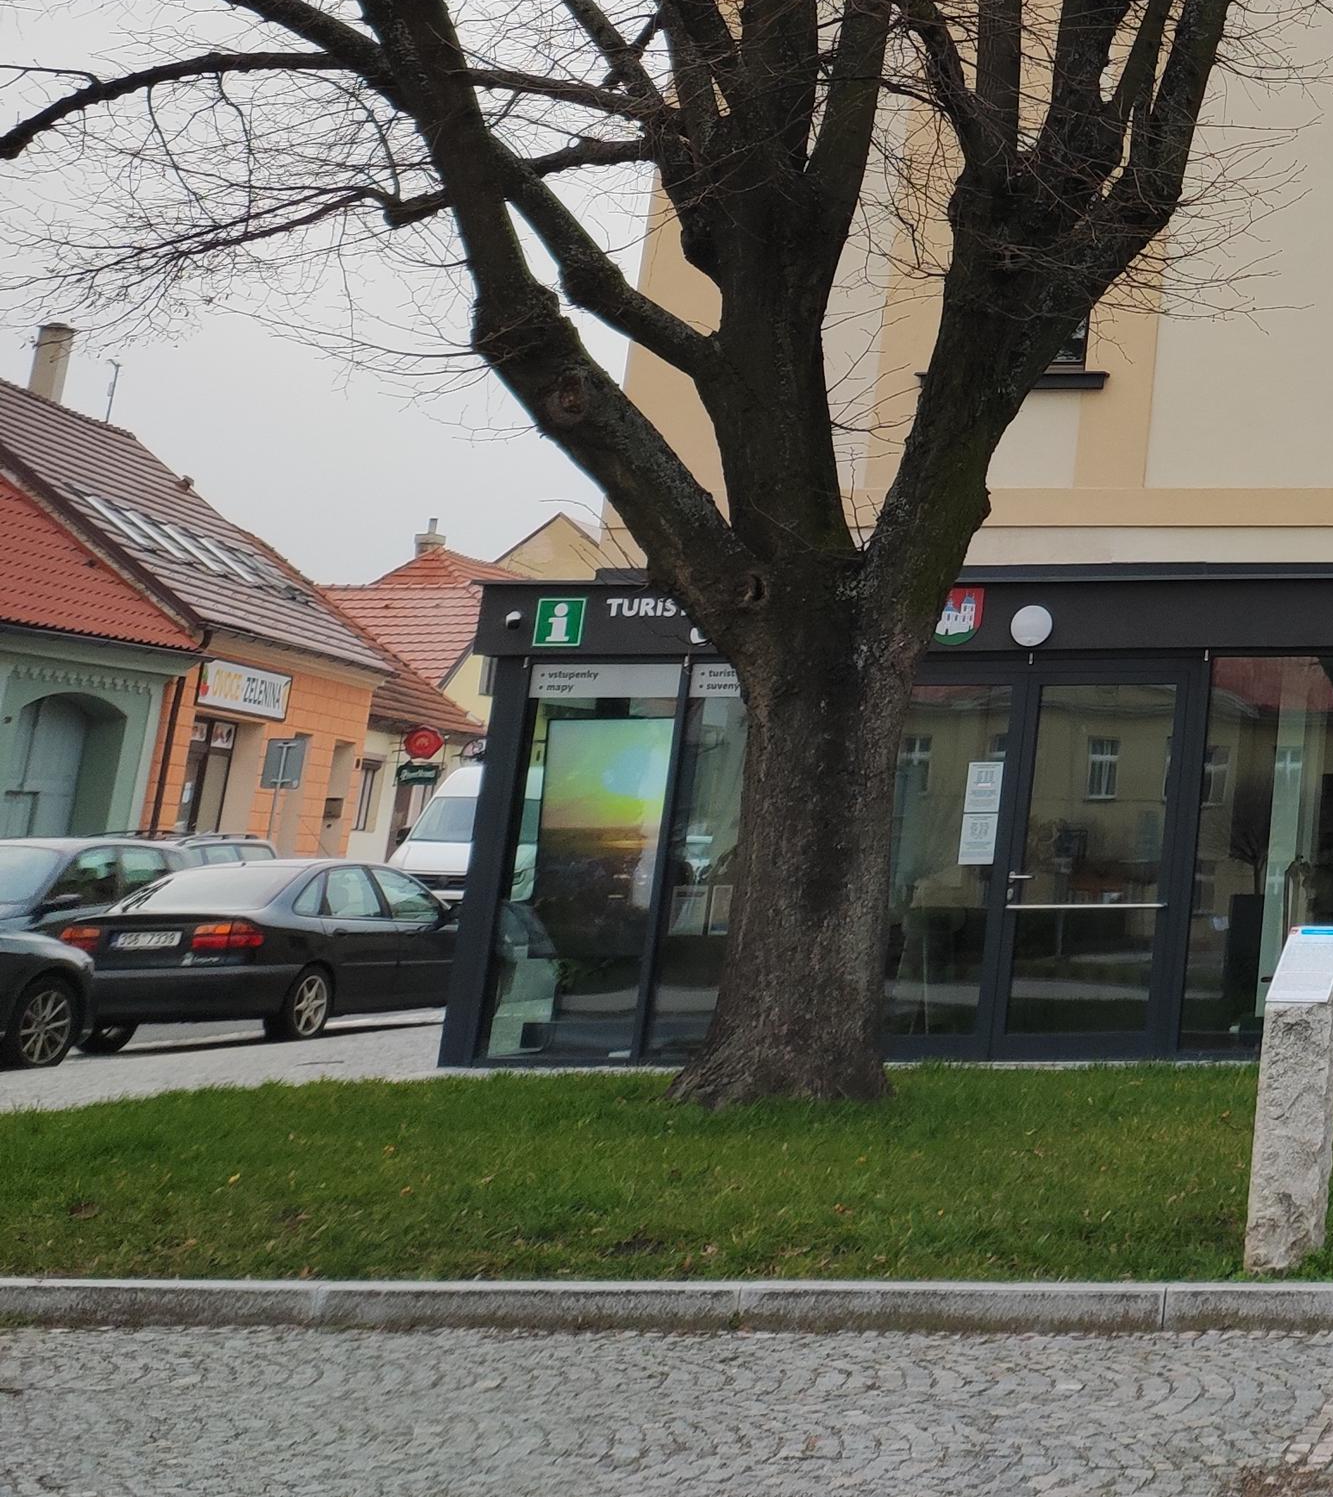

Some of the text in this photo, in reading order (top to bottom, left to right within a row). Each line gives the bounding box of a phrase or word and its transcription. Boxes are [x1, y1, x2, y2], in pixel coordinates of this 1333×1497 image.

[606, 599, 687, 617] TURIS
[548, 670, 599, 680] vstupenky
[243, 676, 282, 710] ZELENINA
[546, 684, 574, 693] mapy
